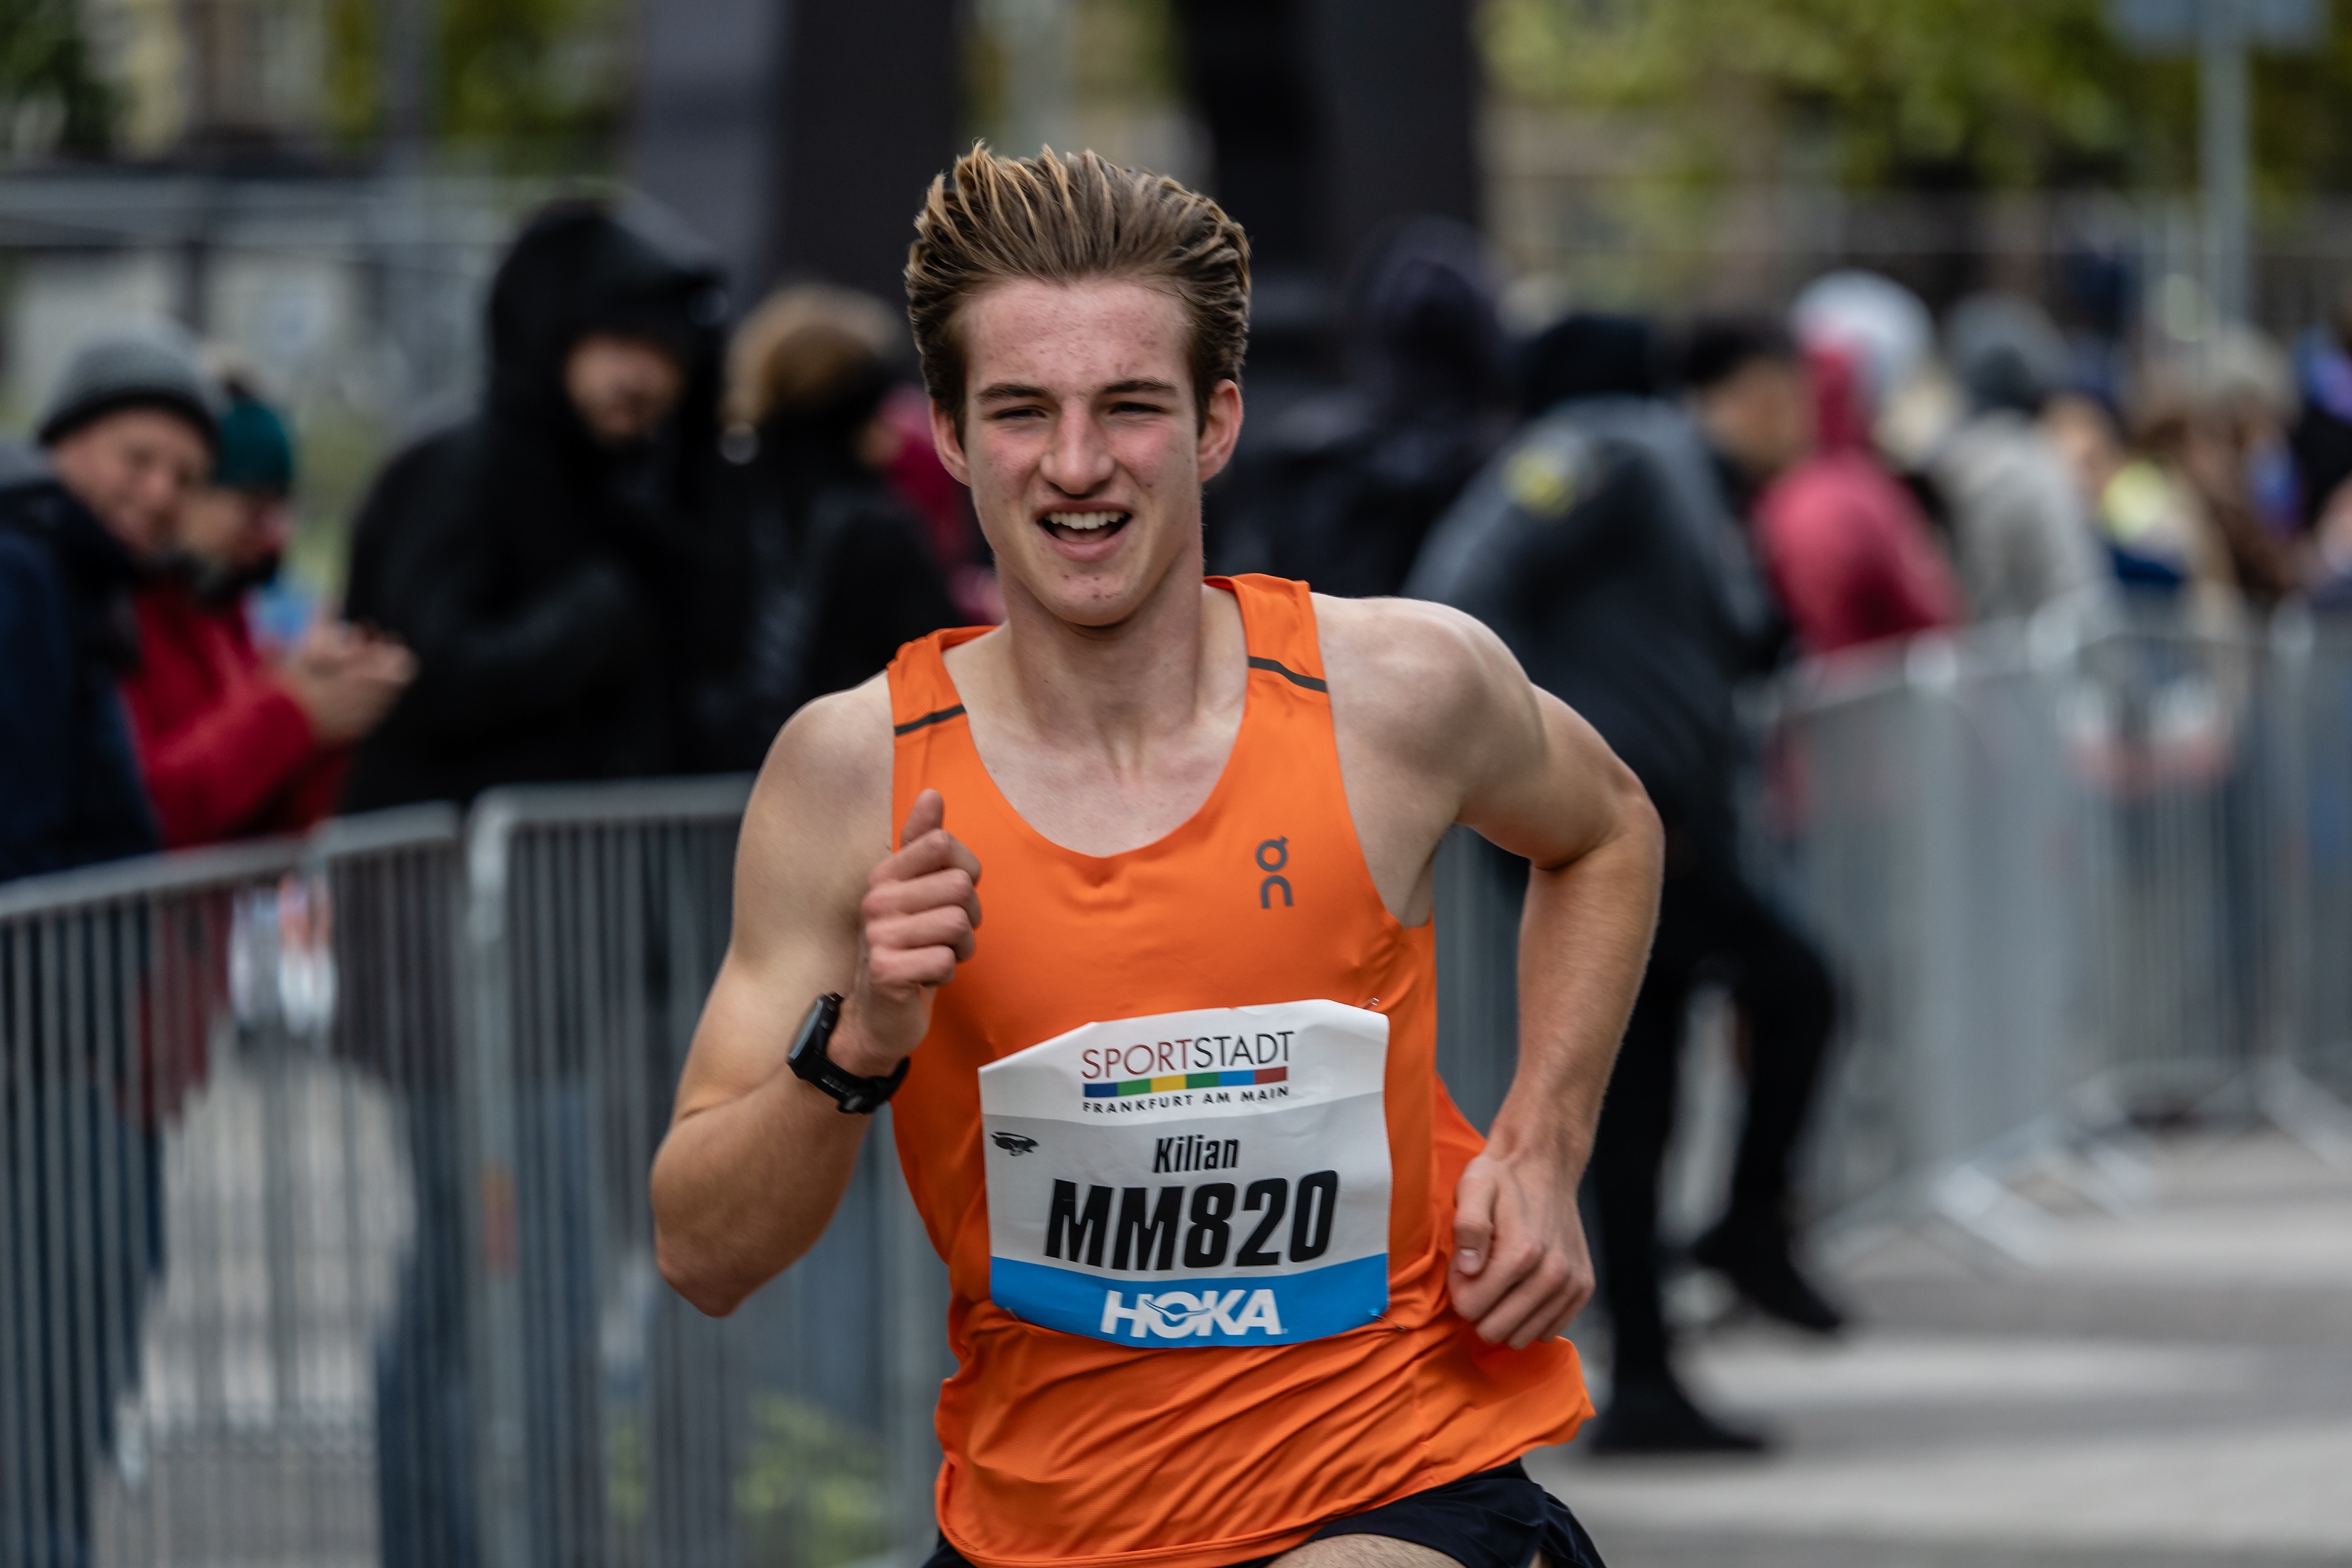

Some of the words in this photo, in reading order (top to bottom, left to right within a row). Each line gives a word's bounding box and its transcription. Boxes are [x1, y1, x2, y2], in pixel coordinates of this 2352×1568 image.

[1081, 1031, 1294, 1079] SPORTSTADT
[1083, 1095, 1193, 1113] FRANKFURT
[1202, 1092, 1232, 1104] AM
[1241, 1085, 1289, 1102] MAIN
[1152, 1134, 1240, 1173] Kilian
[1044, 1170, 1339, 1271] MM820
[1100, 1289, 1282, 1339] HOKA
